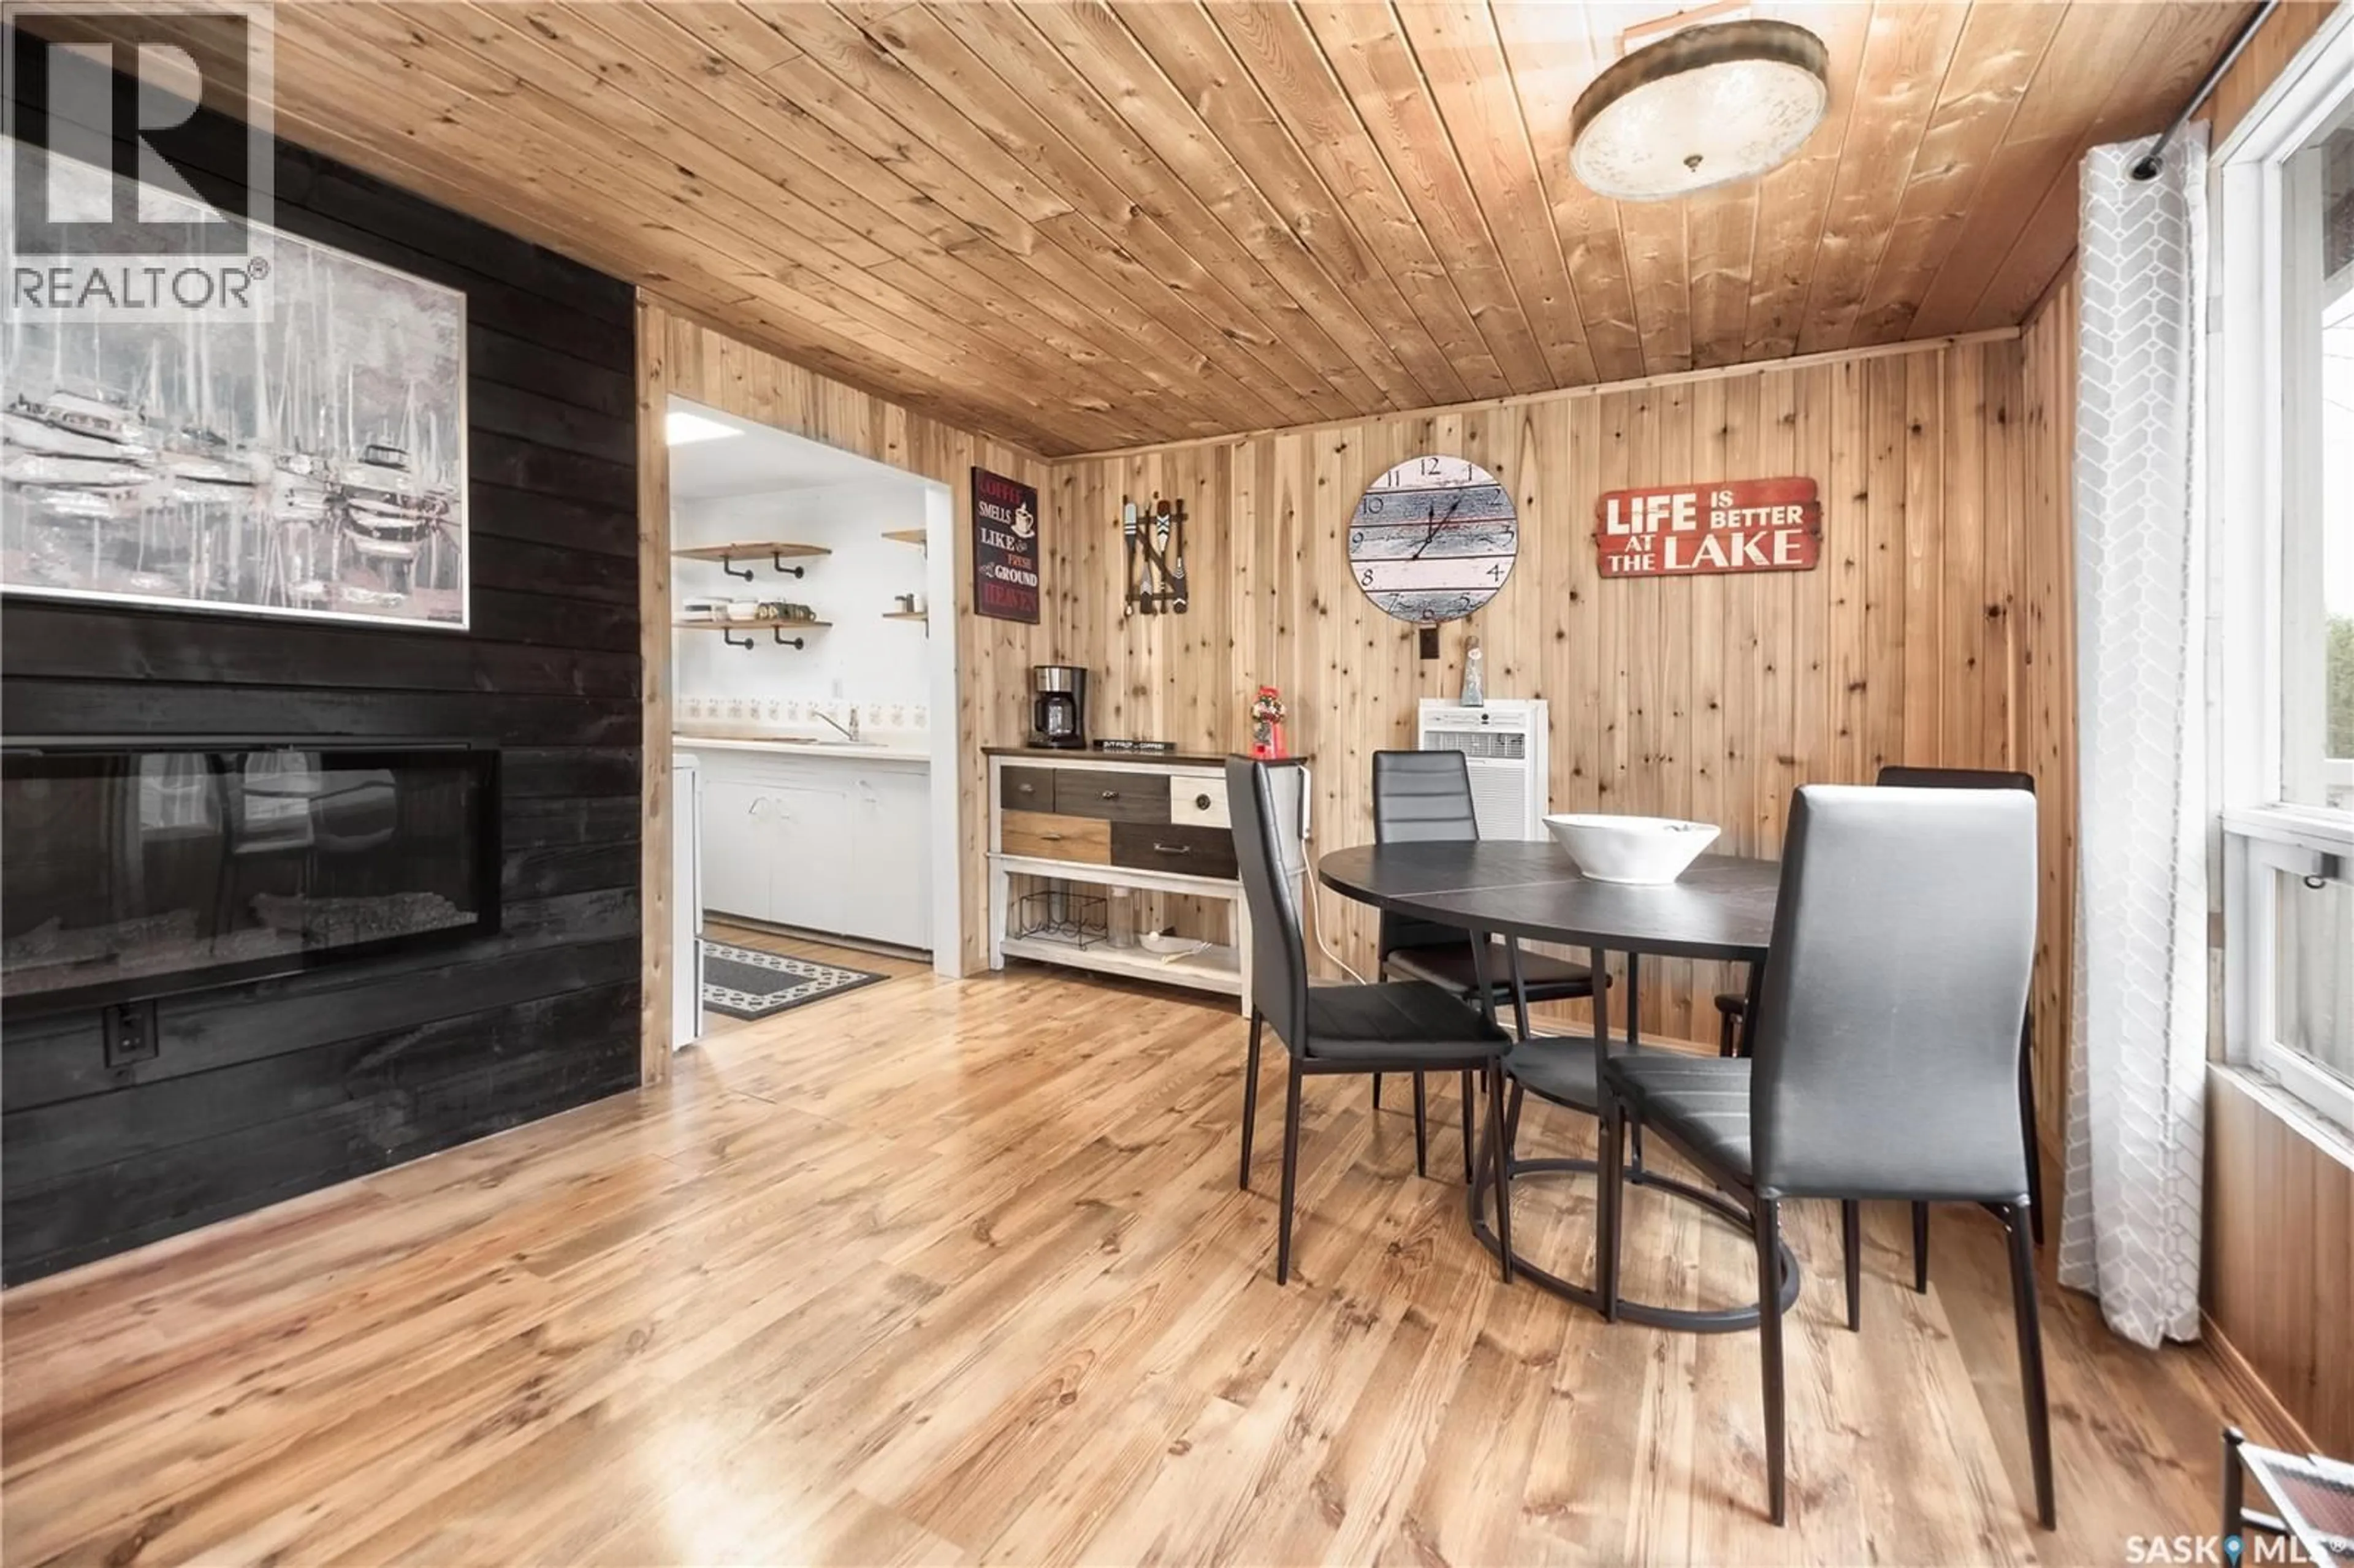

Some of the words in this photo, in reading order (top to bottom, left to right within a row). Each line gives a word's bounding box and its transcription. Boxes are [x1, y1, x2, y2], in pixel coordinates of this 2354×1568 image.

[1420, 457, 1441, 476] 12
[1466, 464, 1473, 481] 1
[1387, 470, 1400, 487] 11
[1363, 497, 1384, 514] 10
[1488, 488, 1502, 506] 2
[1711, 490, 1734, 508] IS
[978, 500, 1011, 525] SMELLS
[1607, 493, 1696, 535] LIFE
[1710, 505, 1804, 529] BETTER
[980, 527, 1015, 552] LIKE
[1352, 532, 1364, 554] 9
[1501, 525, 1515, 547] 3
[1625, 533, 1657, 552] AT
[1664, 529, 1804, 570] LAKE
[1607, 553, 1656, 572] THE
[994, 564, 1038, 587] GROUND
[1360, 568, 1374, 587] 8
[1486, 563, 1504, 582] 4
